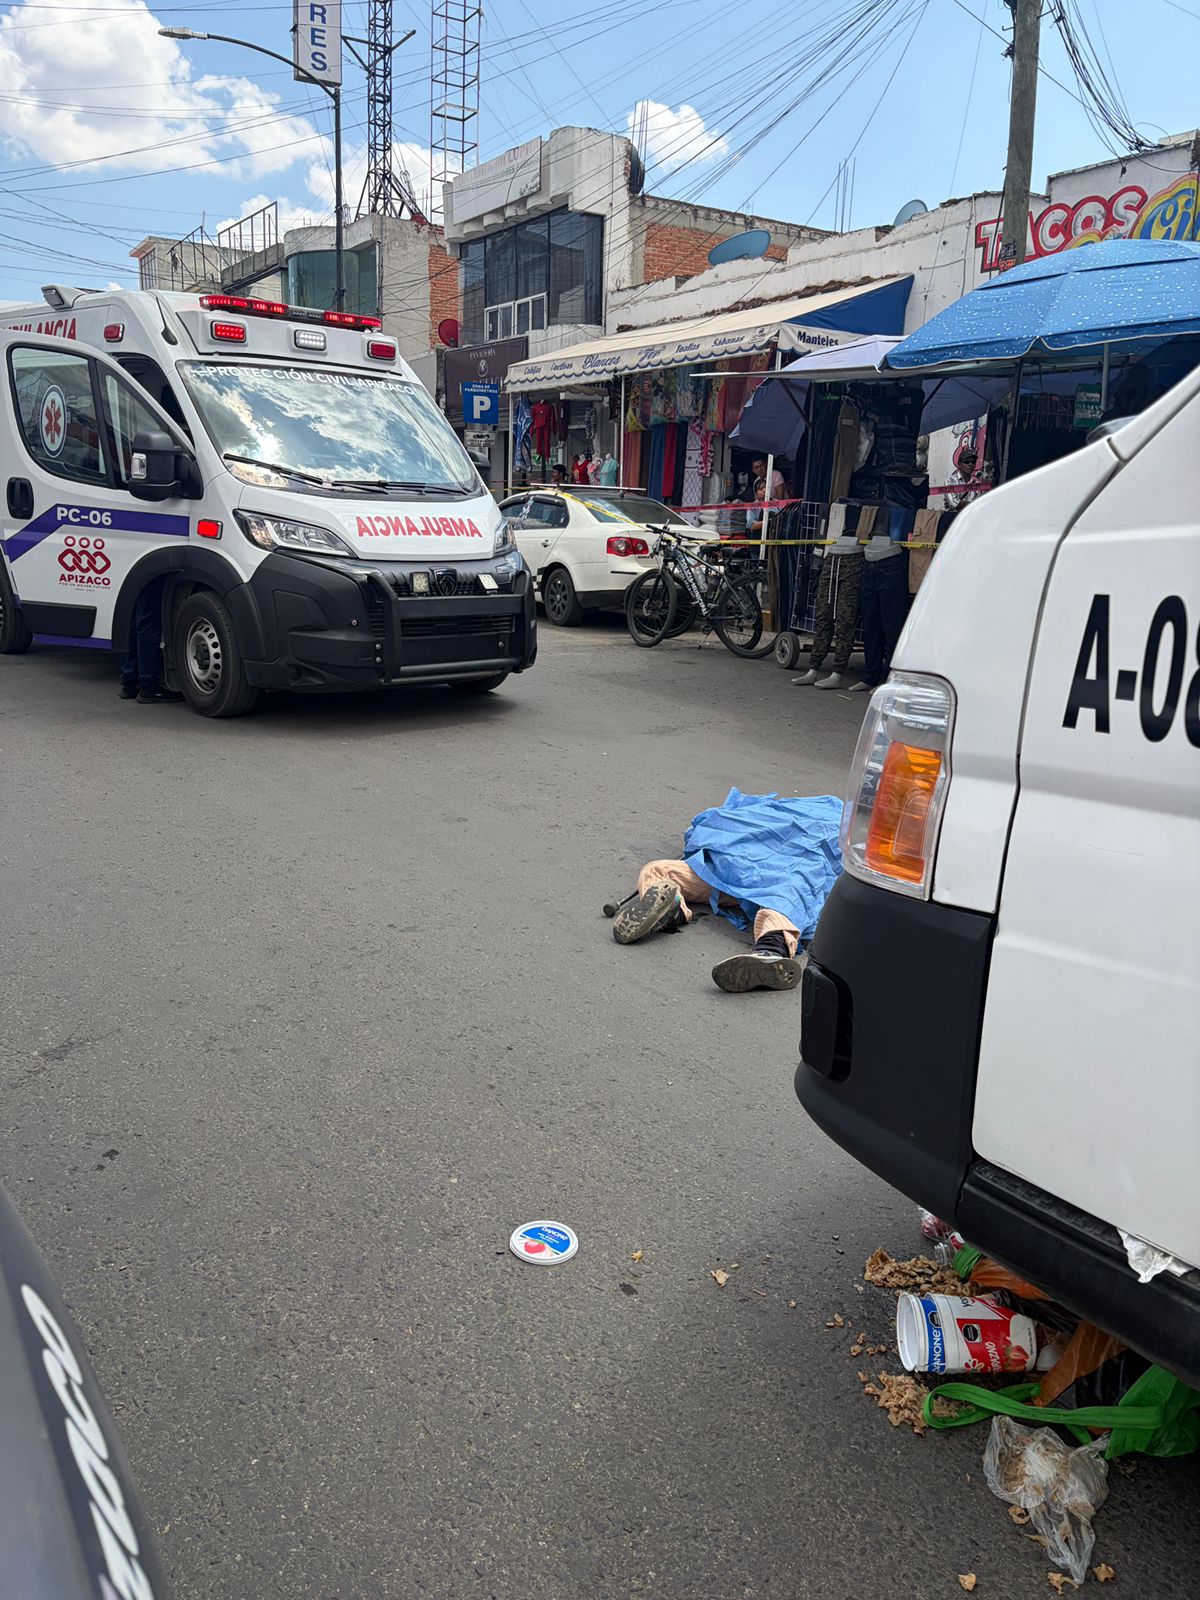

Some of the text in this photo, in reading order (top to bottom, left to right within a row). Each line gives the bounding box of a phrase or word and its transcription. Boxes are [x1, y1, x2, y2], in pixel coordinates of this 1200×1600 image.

[797, 330, 839, 346] Manteles
[582, 353, 621, 369] Blancos
[675, 342, 701, 353] Toallas
[206, 366, 415, 395] PROTECCIÓN CIVIL APIZACO
[473, 395, 491, 419] P
[56, 507, 112, 526] PC-06
[59, 574, 110, 586] APIZACO
